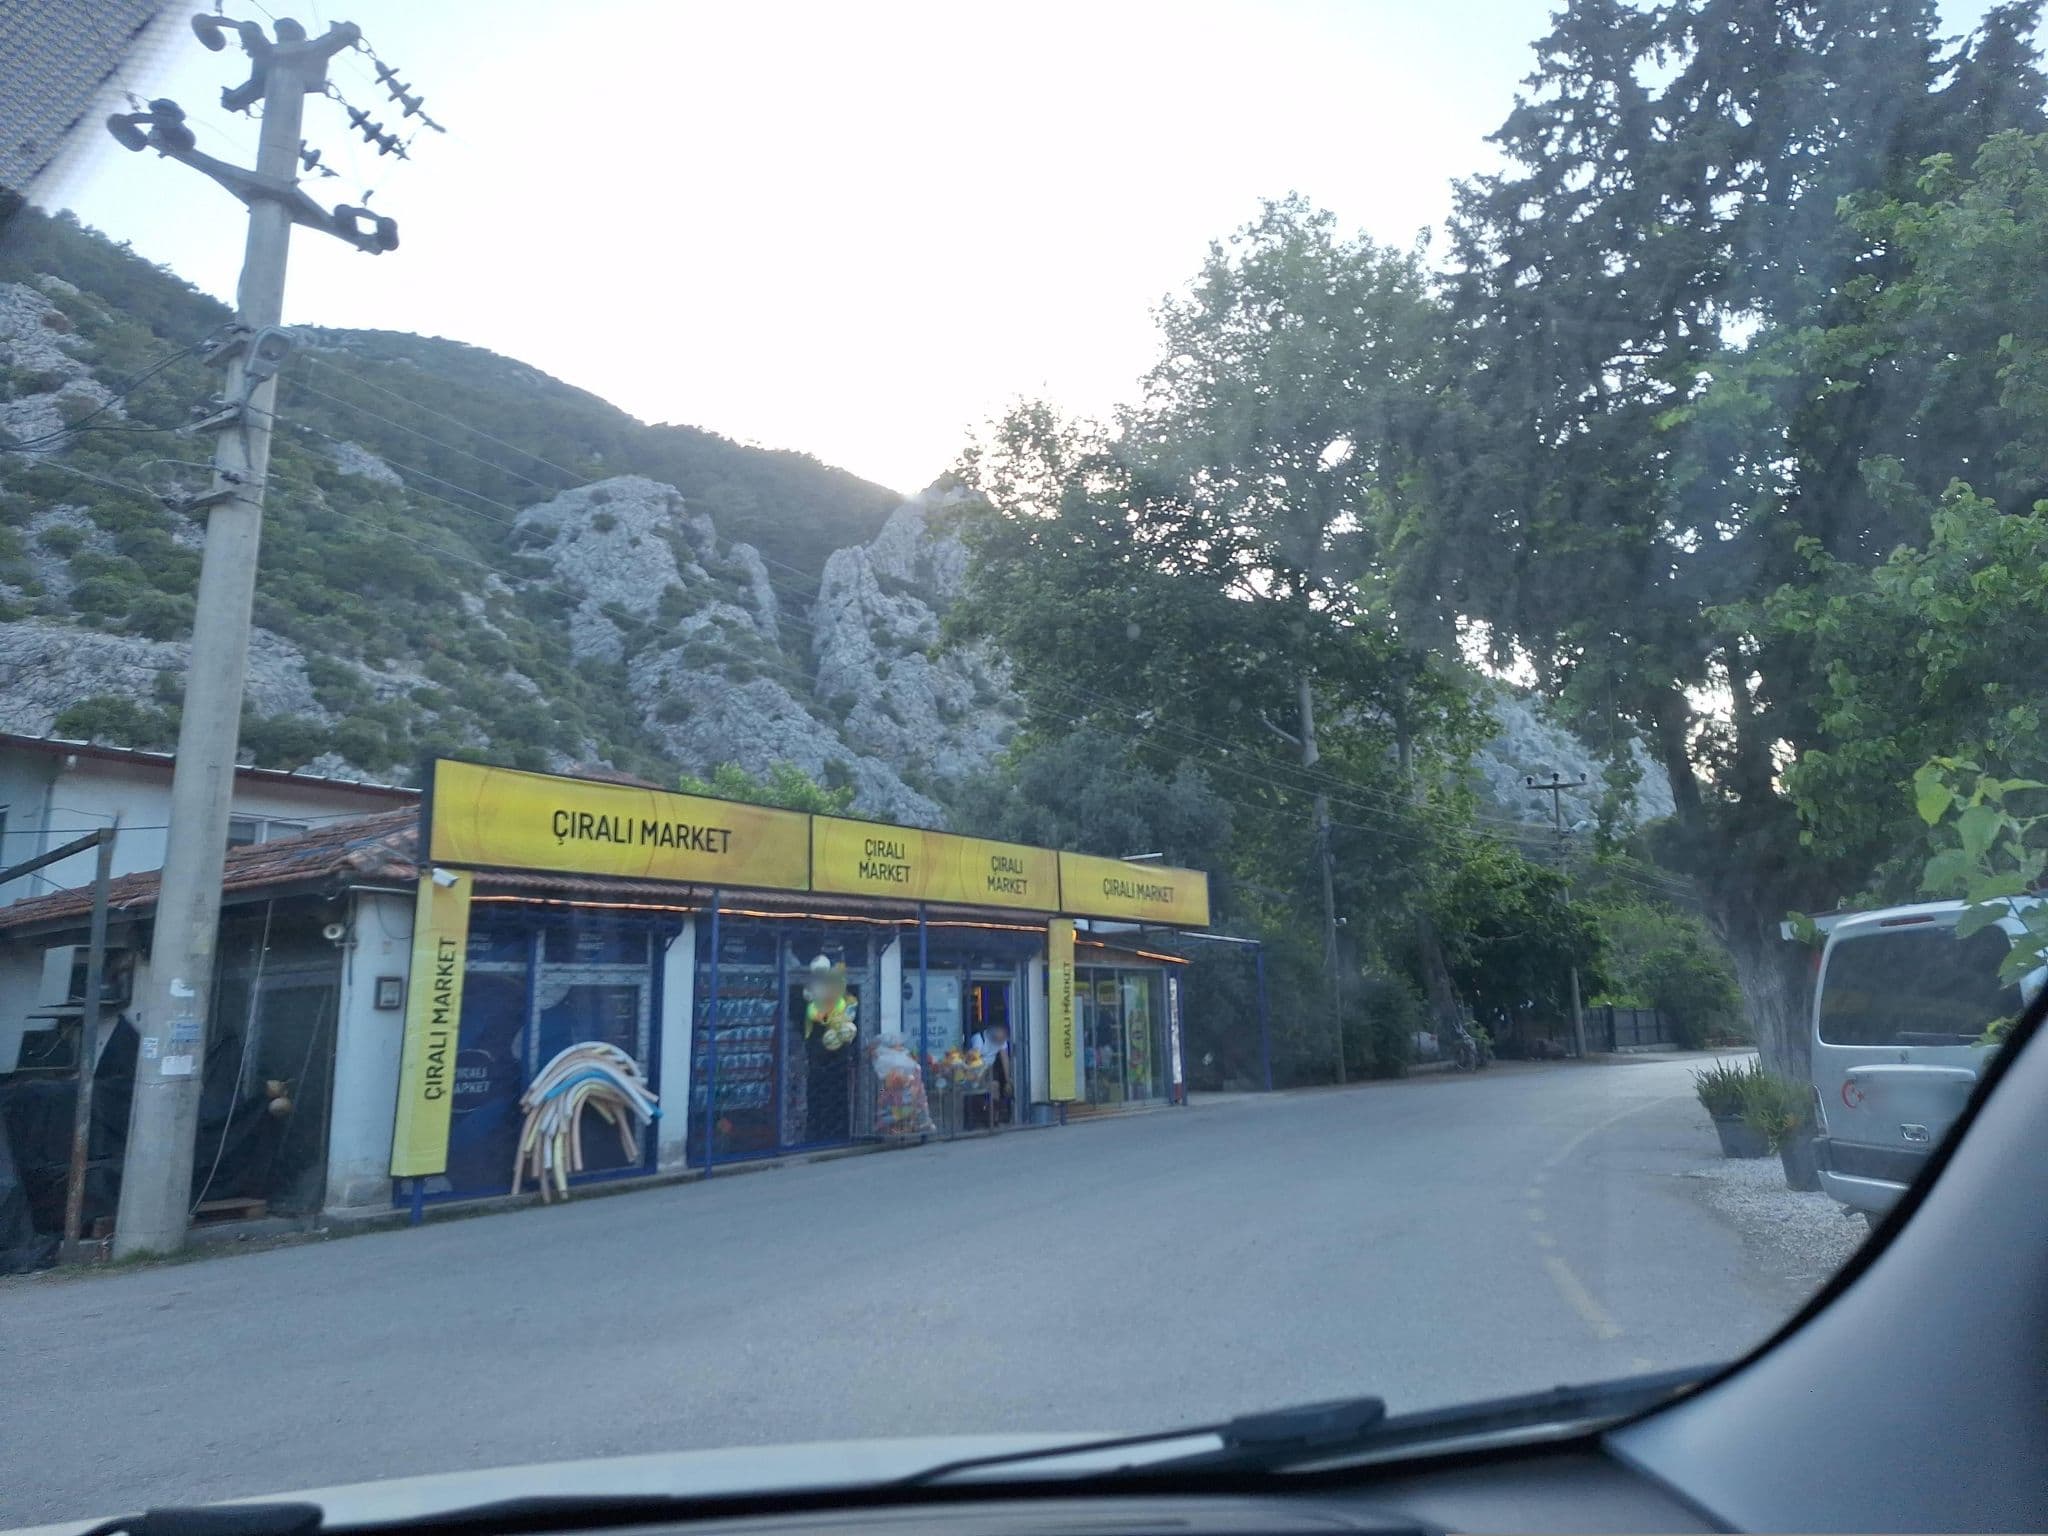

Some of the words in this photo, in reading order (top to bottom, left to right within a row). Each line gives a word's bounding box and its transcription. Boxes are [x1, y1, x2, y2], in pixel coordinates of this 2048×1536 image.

[553, 809, 634, 846] ÇIRALI
[641, 819, 732, 854] MARKET
[864, 838, 905, 860] ÇIRALI
[859, 861, 912, 883] MARKET
[991, 855, 1023, 874] ÇIRALI
[987, 875, 1028, 895] MARKET
[1103, 878, 1136, 900] ÇIRALI
[1136, 884, 1174, 904] MARKET
[432, 937, 456, 1024] MARKET
[424, 1031, 447, 1100] ÇIRALI
